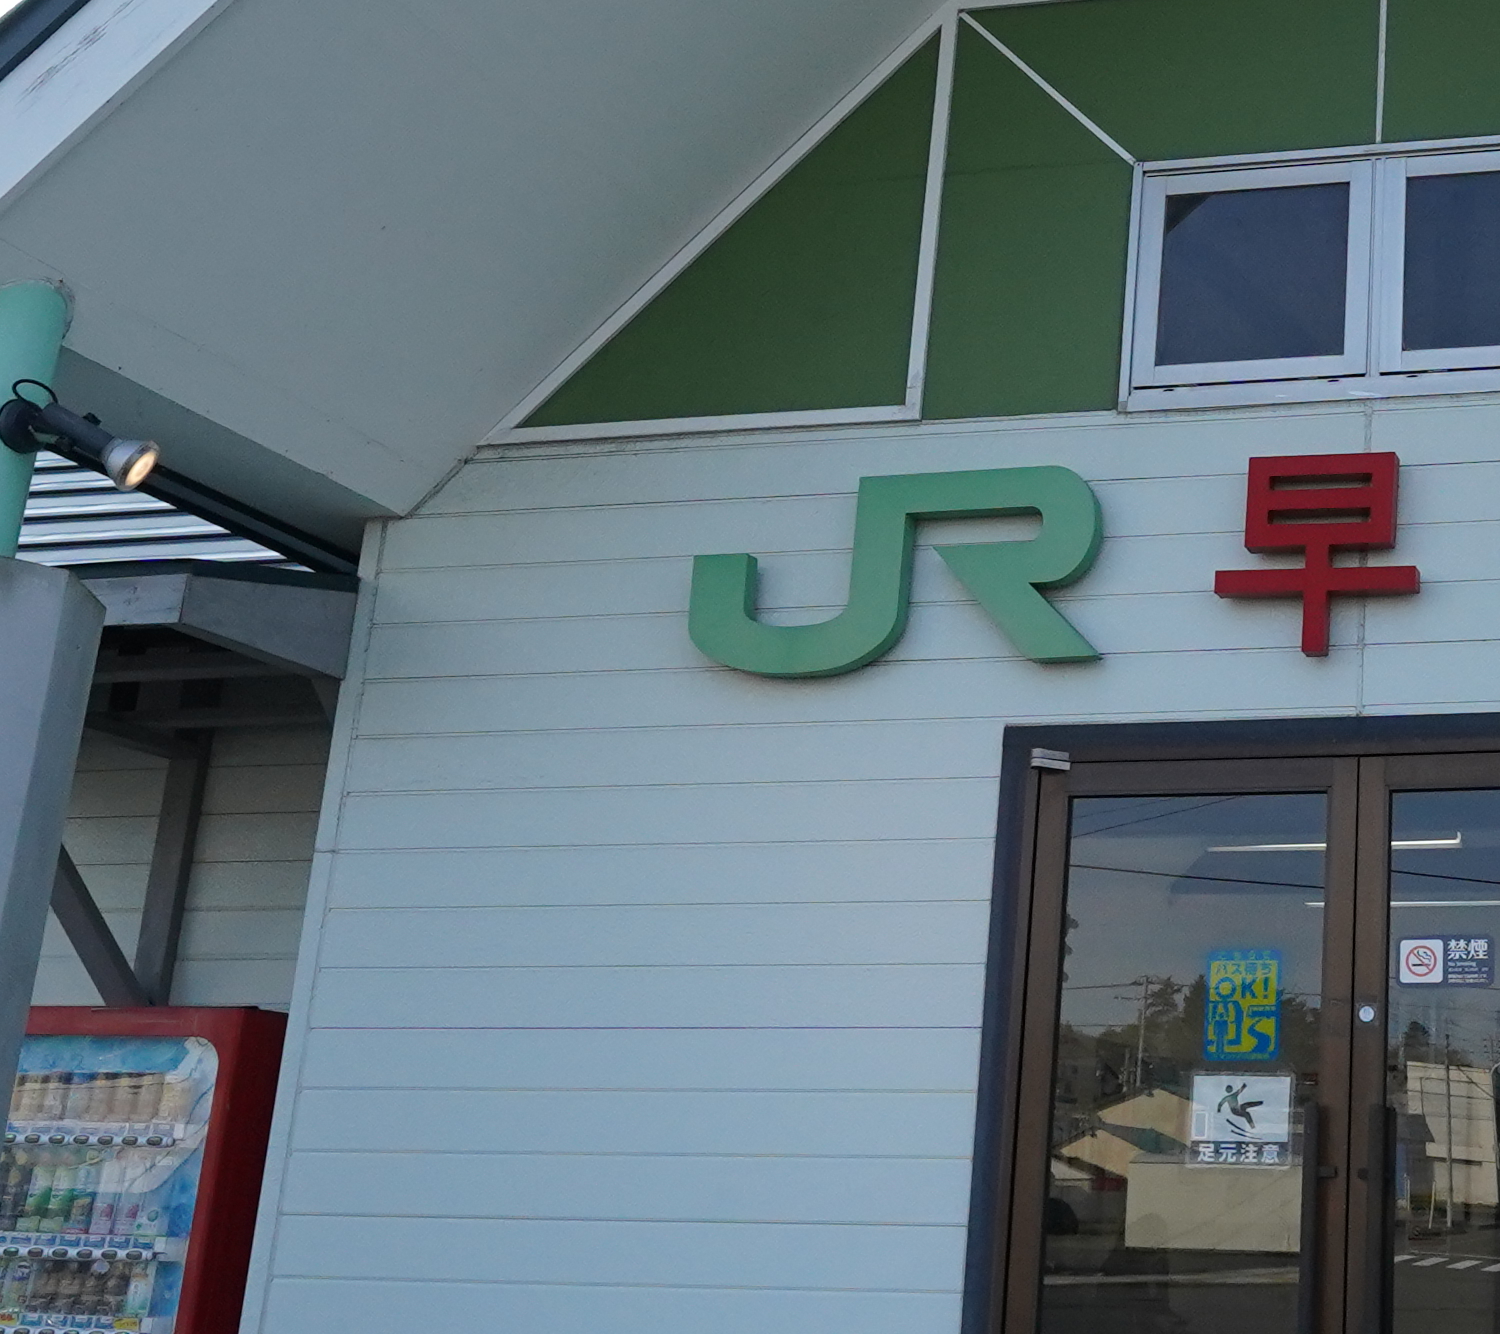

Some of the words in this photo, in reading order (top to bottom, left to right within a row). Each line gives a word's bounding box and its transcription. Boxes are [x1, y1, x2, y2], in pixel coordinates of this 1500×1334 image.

[687, 465, 1102, 677] JR
[1447, 939, 1489, 960] 禁煙
[1214, 976, 1270, 1000] OK!
[1197, 1143, 1280, 1163] 足元注意
